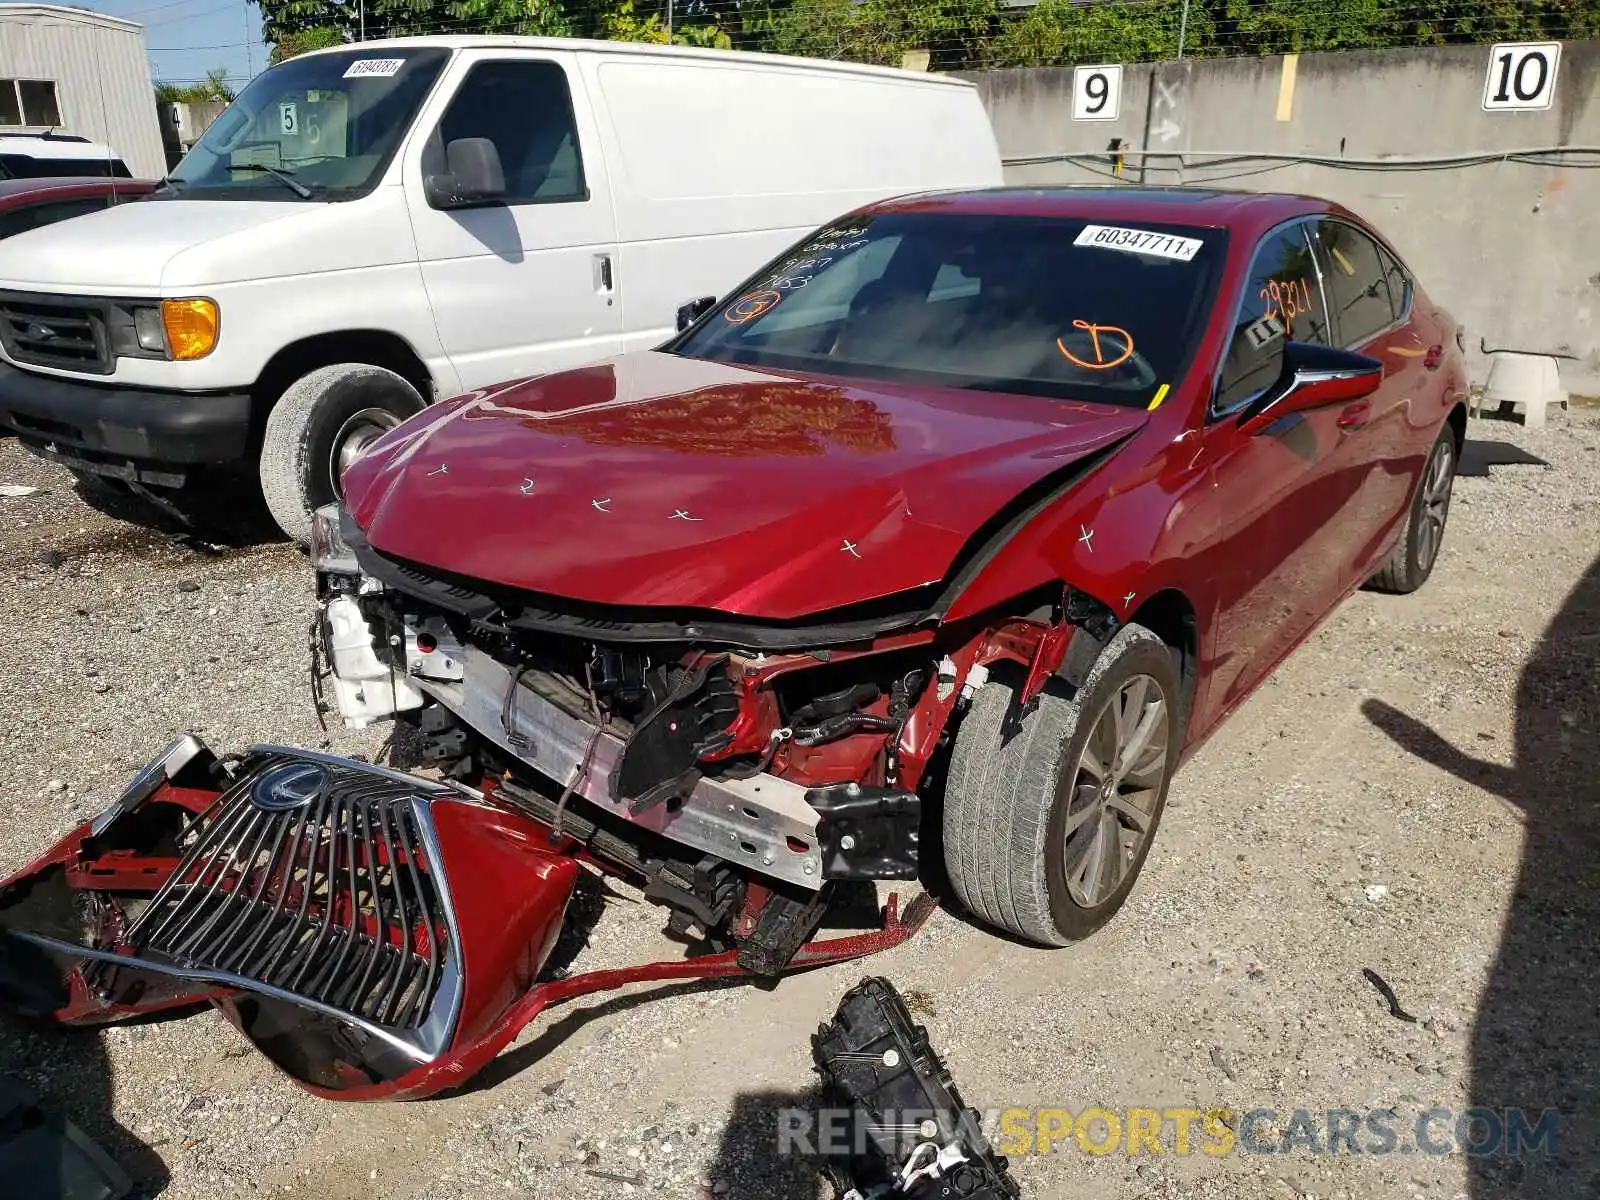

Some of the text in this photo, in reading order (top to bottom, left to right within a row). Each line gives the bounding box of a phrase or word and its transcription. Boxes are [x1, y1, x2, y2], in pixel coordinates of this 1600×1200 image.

[1493, 51, 1548, 102] 10
[1085, 72, 1109, 114] 9
[173, 107, 180, 128] 4
[284, 107, 293, 130] 5
[1094, 228, 1186, 254] 60347711
